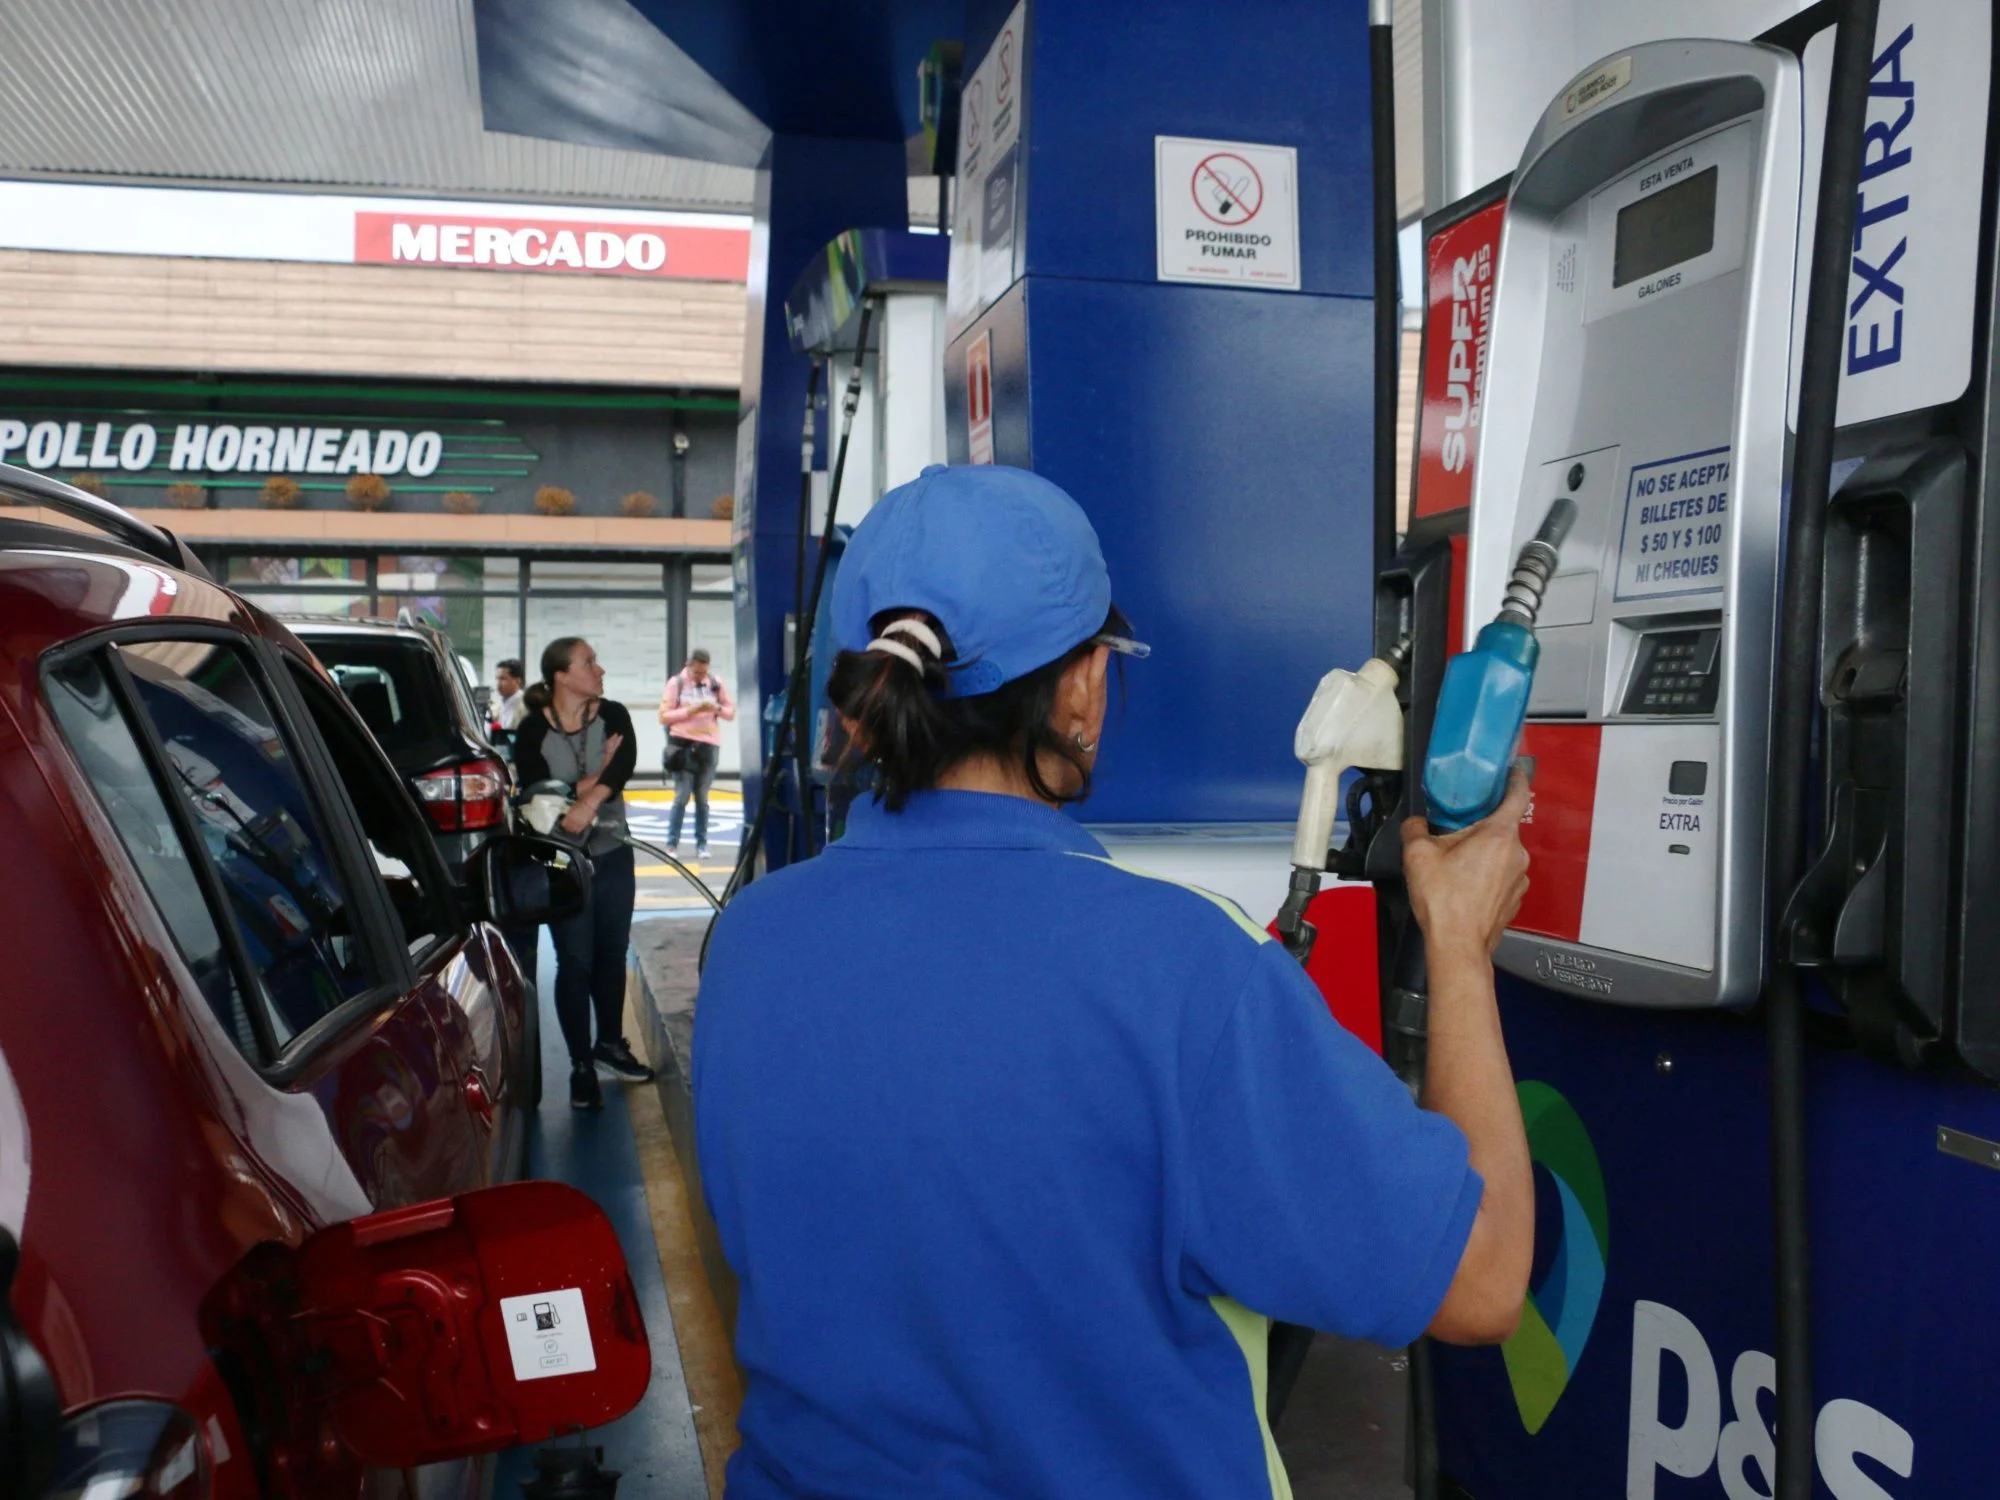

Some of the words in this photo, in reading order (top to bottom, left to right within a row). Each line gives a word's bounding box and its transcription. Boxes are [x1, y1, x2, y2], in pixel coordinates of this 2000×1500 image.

[1640, 171, 1662, 191] ESTA
[1664, 157, 1694, 179] VENTA
[1847, 23, 1915, 376] EXTRA
[392, 223, 666, 271] MERCADO
[1185, 229, 1272, 247] PROHIBIDO
[1201, 245, 1257, 260] FUMAR
[1478, 243, 1491, 282] 95
[1638, 272, 1682, 299] GALONES
[1441, 251, 1478, 475] SUPER
[0, 419, 157, 471] POLLO
[169, 424, 443, 478] HORNEADO
[1636, 478, 1656, 497] NO
[1658, 473, 1677, 493] SE
[1641, 497, 1703, 525] BILLETES
[1707, 492, 1728, 514] DE
[1641, 534, 1649, 554] $
[1652, 532, 1668, 552] 50
[1672, 530, 1682, 549] Y
[1684, 527, 1693, 549] $
[1697, 523, 1722, 546] 100
[1636, 564, 1650, 583] NI
[1653, 555, 1719, 582] CHEQUES
[1660, 813, 1701, 832] EXTRA
